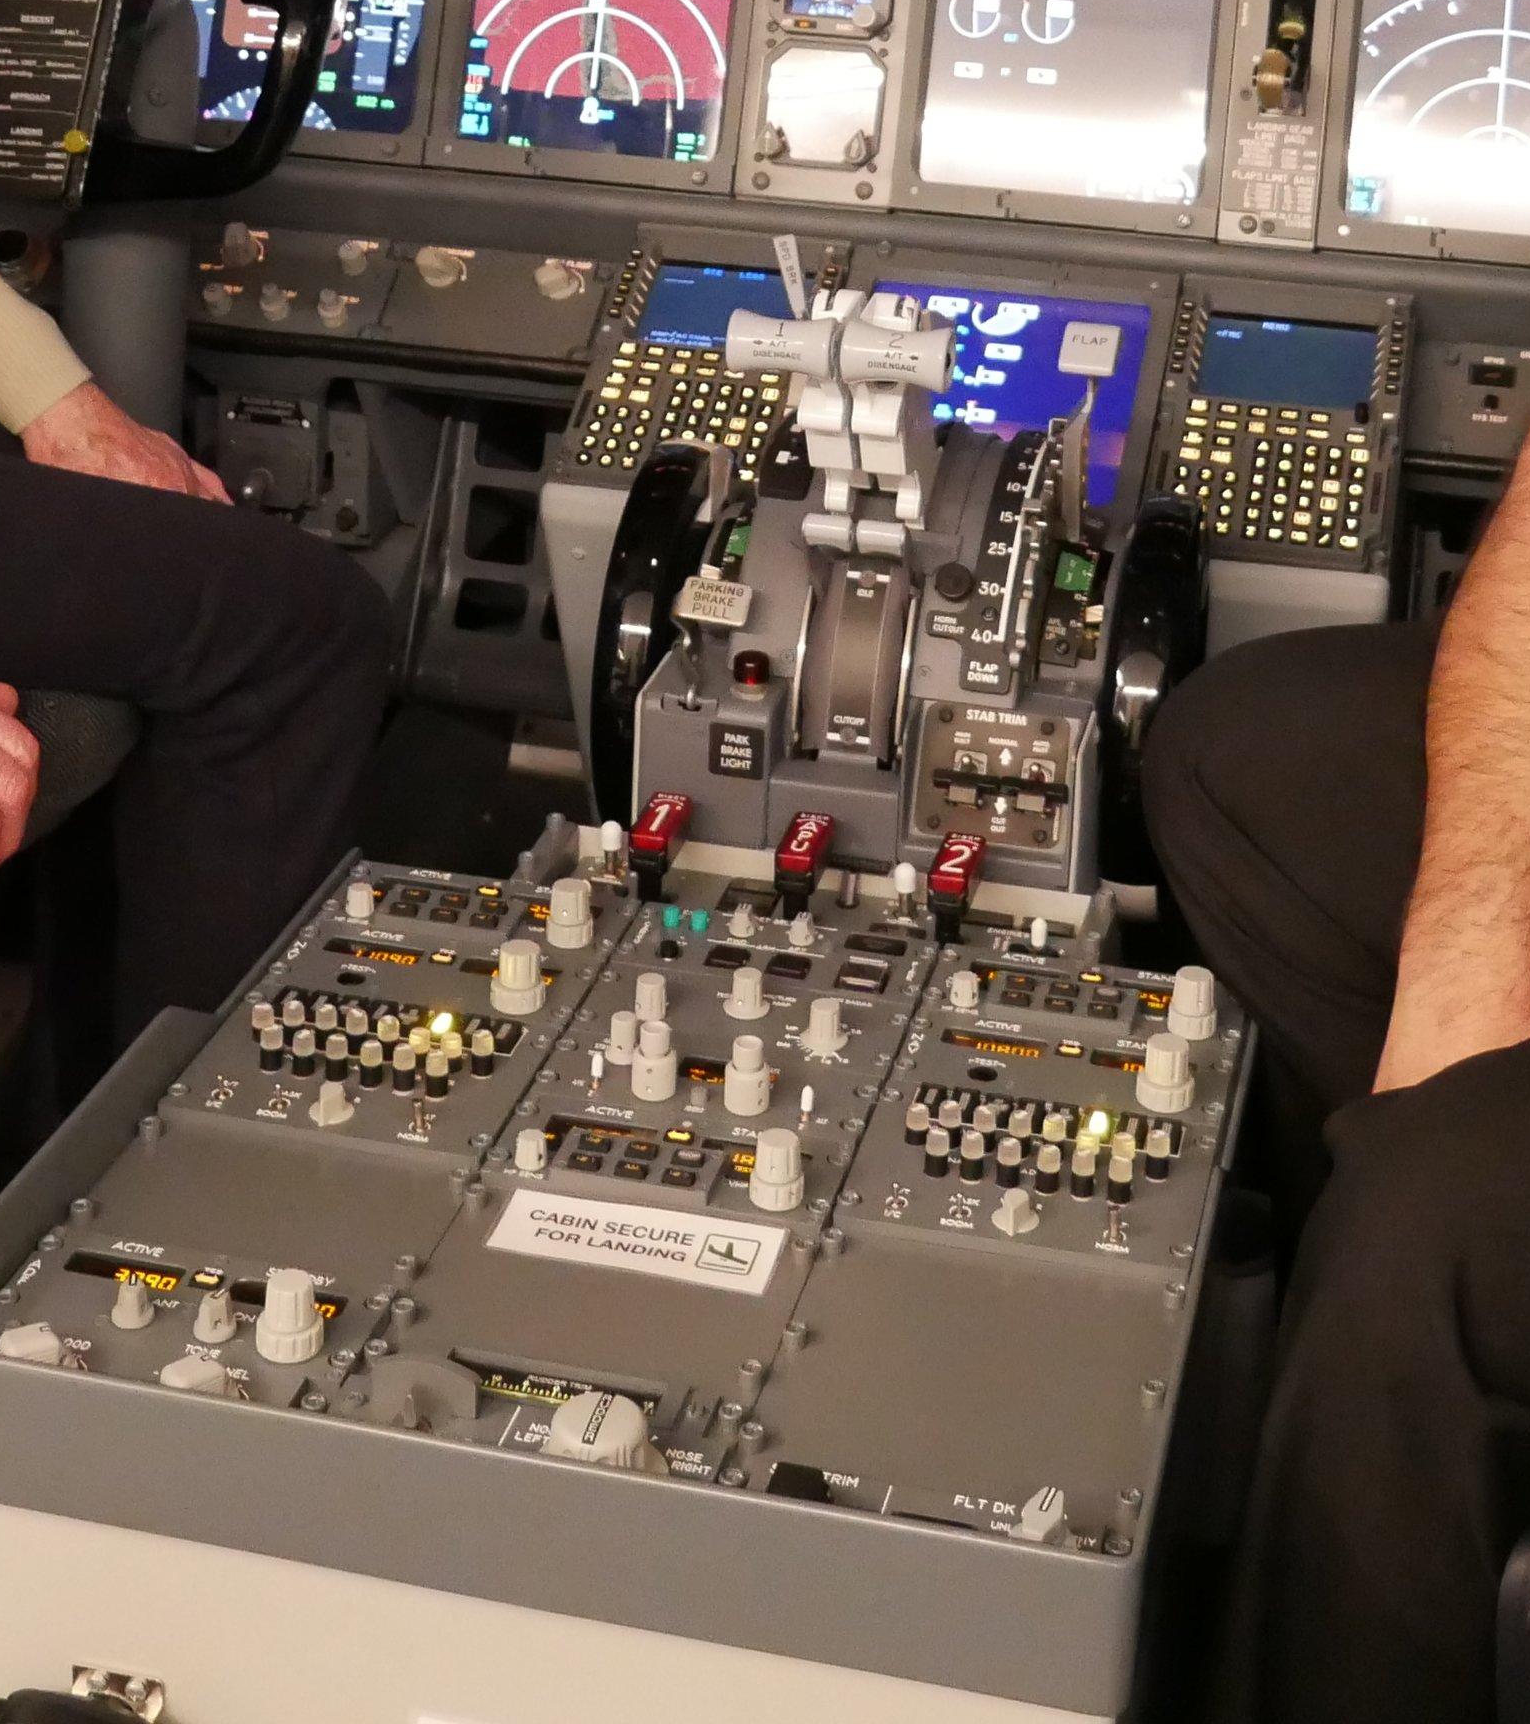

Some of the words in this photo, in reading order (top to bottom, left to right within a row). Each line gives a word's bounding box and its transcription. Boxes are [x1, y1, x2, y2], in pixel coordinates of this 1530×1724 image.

[888, 332, 903, 348] 2
[1071, 334, 1108, 345] FLAP
[752, 349, 802, 361] DISENGAGE
[884, 352, 902, 360] A/T
[867, 360, 917, 373] DISENGAGE
[999, 512, 1014, 522] 15
[987, 542, 1007, 555] 25
[690, 580, 744, 596] PARKING
[978, 583, 998, 596] 30
[693, 591, 736, 607] BRAKE
[692, 603, 730, 618] PULL
[933, 615, 957, 625] HORN
[932, 623, 964, 634] CUTOUT
[970, 629, 993, 643] 40
[969, 661, 999, 673] FLAP
[967, 671, 999, 684] DOWN
[833, 715, 866, 726] CUTOFF
[966, 709, 996, 723] STAB
[998, 713, 1028, 726] TRIM
[723, 732, 750, 746] PARK
[720, 744, 753, 758] BRAKE
[720, 756, 752, 771] LIGHT
[650, 804, 670, 832] 1
[939, 845, 972, 873] 2
[408, 869, 452, 880] ACTIVE
[360, 929, 405, 941] ACTIVE
[1001, 953, 1046, 965] ACTIVE
[975, 1020, 1022, 1032] ACTIVE
[584, 1105, 634, 1119] ACTIVE
[397, 1132, 429, 1143] NORM
[528, 1210, 598, 1231] CABIN
[602, 1220, 696, 1247] SECURE
[940, 1218, 974, 1229] BOOM
[111, 1241, 164, 1257] ACTIVE
[534, 1227, 583, 1245] FOR
[587, 1235, 688, 1262] LANDING
[1095, 1241, 1129, 1253] NORM
[152, 1299, 180, 1309] ANT
[583, 1394, 613, 1441] RUDDER
[665, 1448, 704, 1463] NOSE
[671, 1461, 713, 1476] RIGHT
[822, 1470, 861, 1489] TRIM
[952, 1494, 989, 1512] FLT
[992, 1498, 1017, 1515] DK
